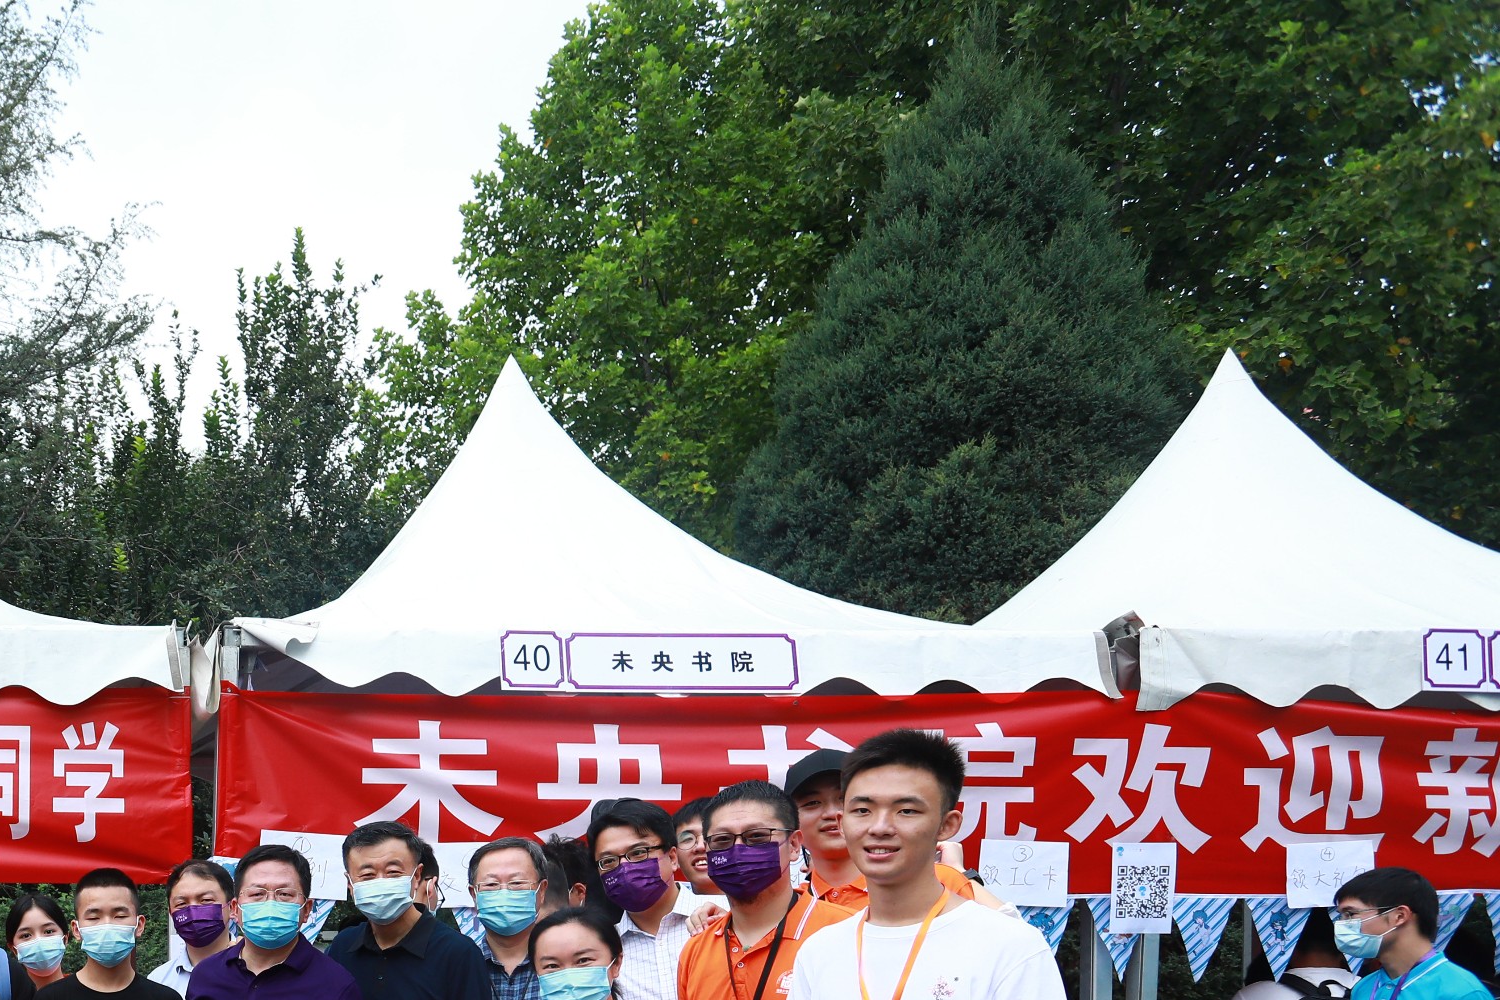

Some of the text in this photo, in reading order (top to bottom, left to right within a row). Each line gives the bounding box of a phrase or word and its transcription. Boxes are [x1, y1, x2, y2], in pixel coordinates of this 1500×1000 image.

[512, 645, 552, 673] 40
[611, 650, 755, 673] 未央书院
[1435, 642, 1470, 672] 41
